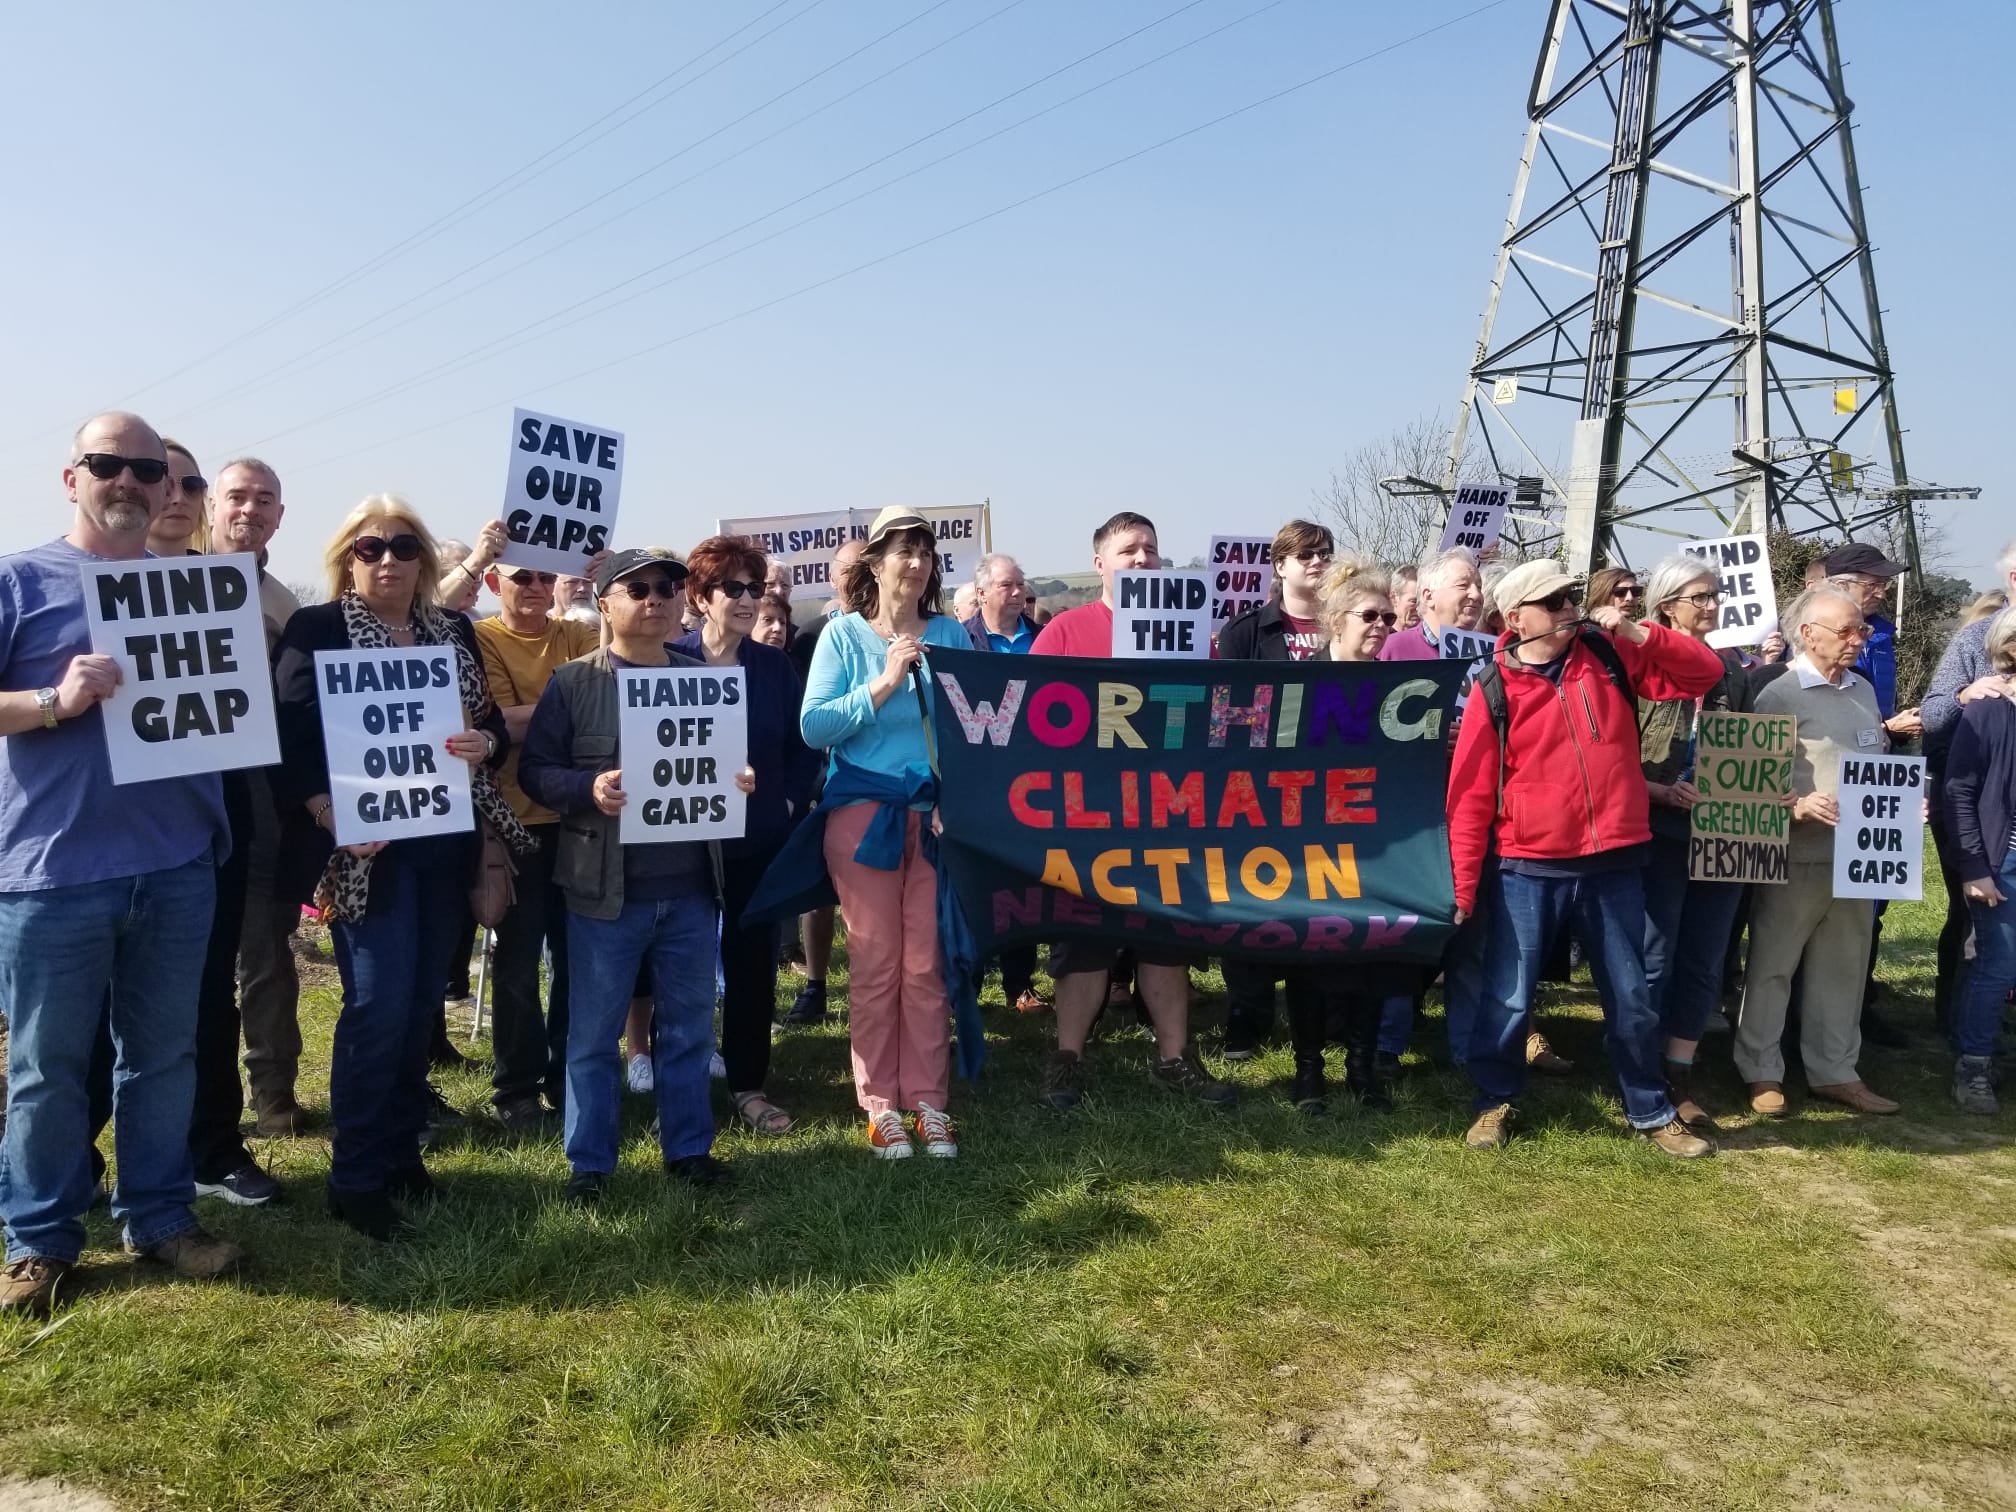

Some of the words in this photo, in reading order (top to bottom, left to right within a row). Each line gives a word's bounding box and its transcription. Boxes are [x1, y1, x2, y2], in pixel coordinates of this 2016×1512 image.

[519, 418, 617, 470] SAVE
[526, 466, 602, 513] OUR
[1457, 488, 1508, 506] HANDS
[507, 509, 608, 556] GAPS
[1464, 511, 1490, 527] OFF
[789, 526, 846, 552] SPACE
[1213, 542, 1271, 565] SAVE
[1455, 532, 1484, 548] OUR
[96, 566, 247, 621] MIND
[1121, 577, 1206, 609] MIND
[1216, 571, 1261, 592] OUR
[1132, 620, 1194, 651] THE
[125, 628, 238, 681] THE
[325, 658, 450, 694] HANDS
[627, 677, 740, 707] HANDS
[132, 689, 249, 742] GAP
[363, 702, 424, 735] OFF
[936, 671, 1441, 749] WORTHING
[657, 717, 713, 747] OFF
[1699, 715, 1749, 749] KEEP
[1752, 719, 1791, 751] OFF
[364, 744, 437, 778] OUR
[653, 757, 717, 787] OUR
[1716, 758, 1778, 793] OUR
[1844, 761, 1920, 787] HANDS
[357, 785, 451, 823] GAPS
[642, 795, 726, 825] GAPS
[1008, 767, 1377, 829] CLIMATE
[1862, 794, 1900, 819] OFF
[1857, 827, 1902, 852] OUR
[1040, 843, 1361, 905] ACTION
[1690, 837, 1789, 881] PERSIMMON
[1848, 859, 1908, 884] GAPS
